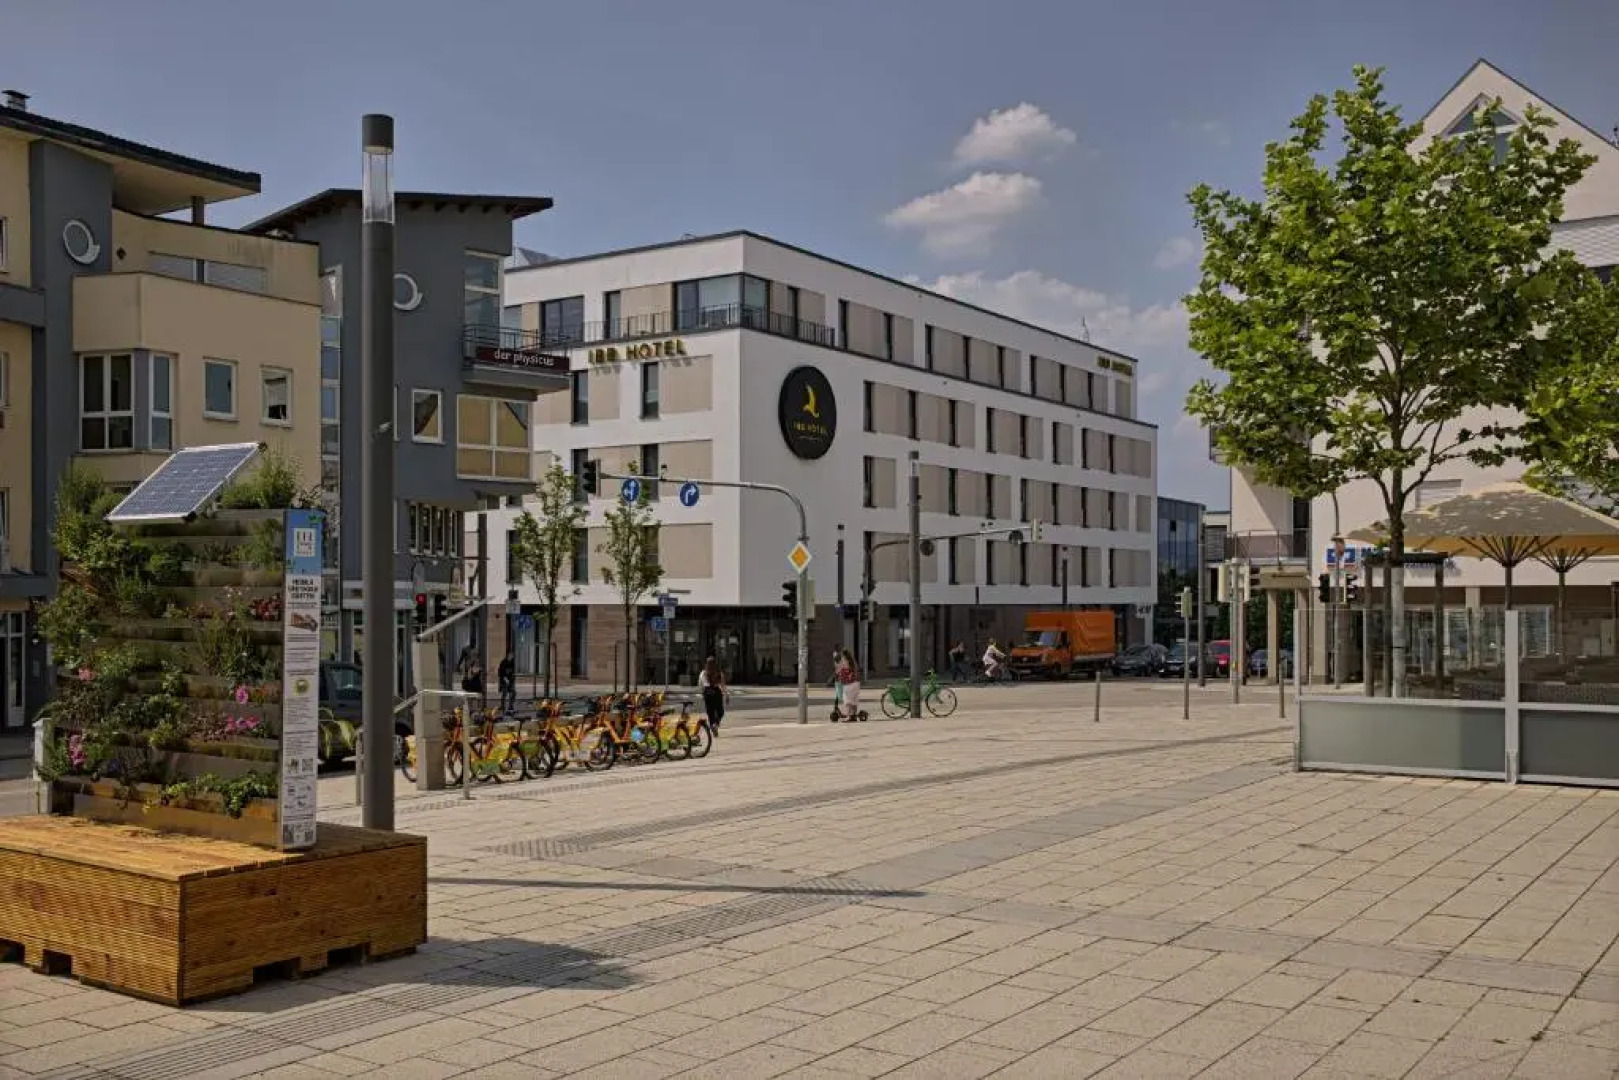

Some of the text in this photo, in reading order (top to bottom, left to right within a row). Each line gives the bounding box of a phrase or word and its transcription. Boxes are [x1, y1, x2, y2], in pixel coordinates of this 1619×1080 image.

[494, 348, 555, 366] der physicus
[588, 339, 687, 363] IBB HOTEL
